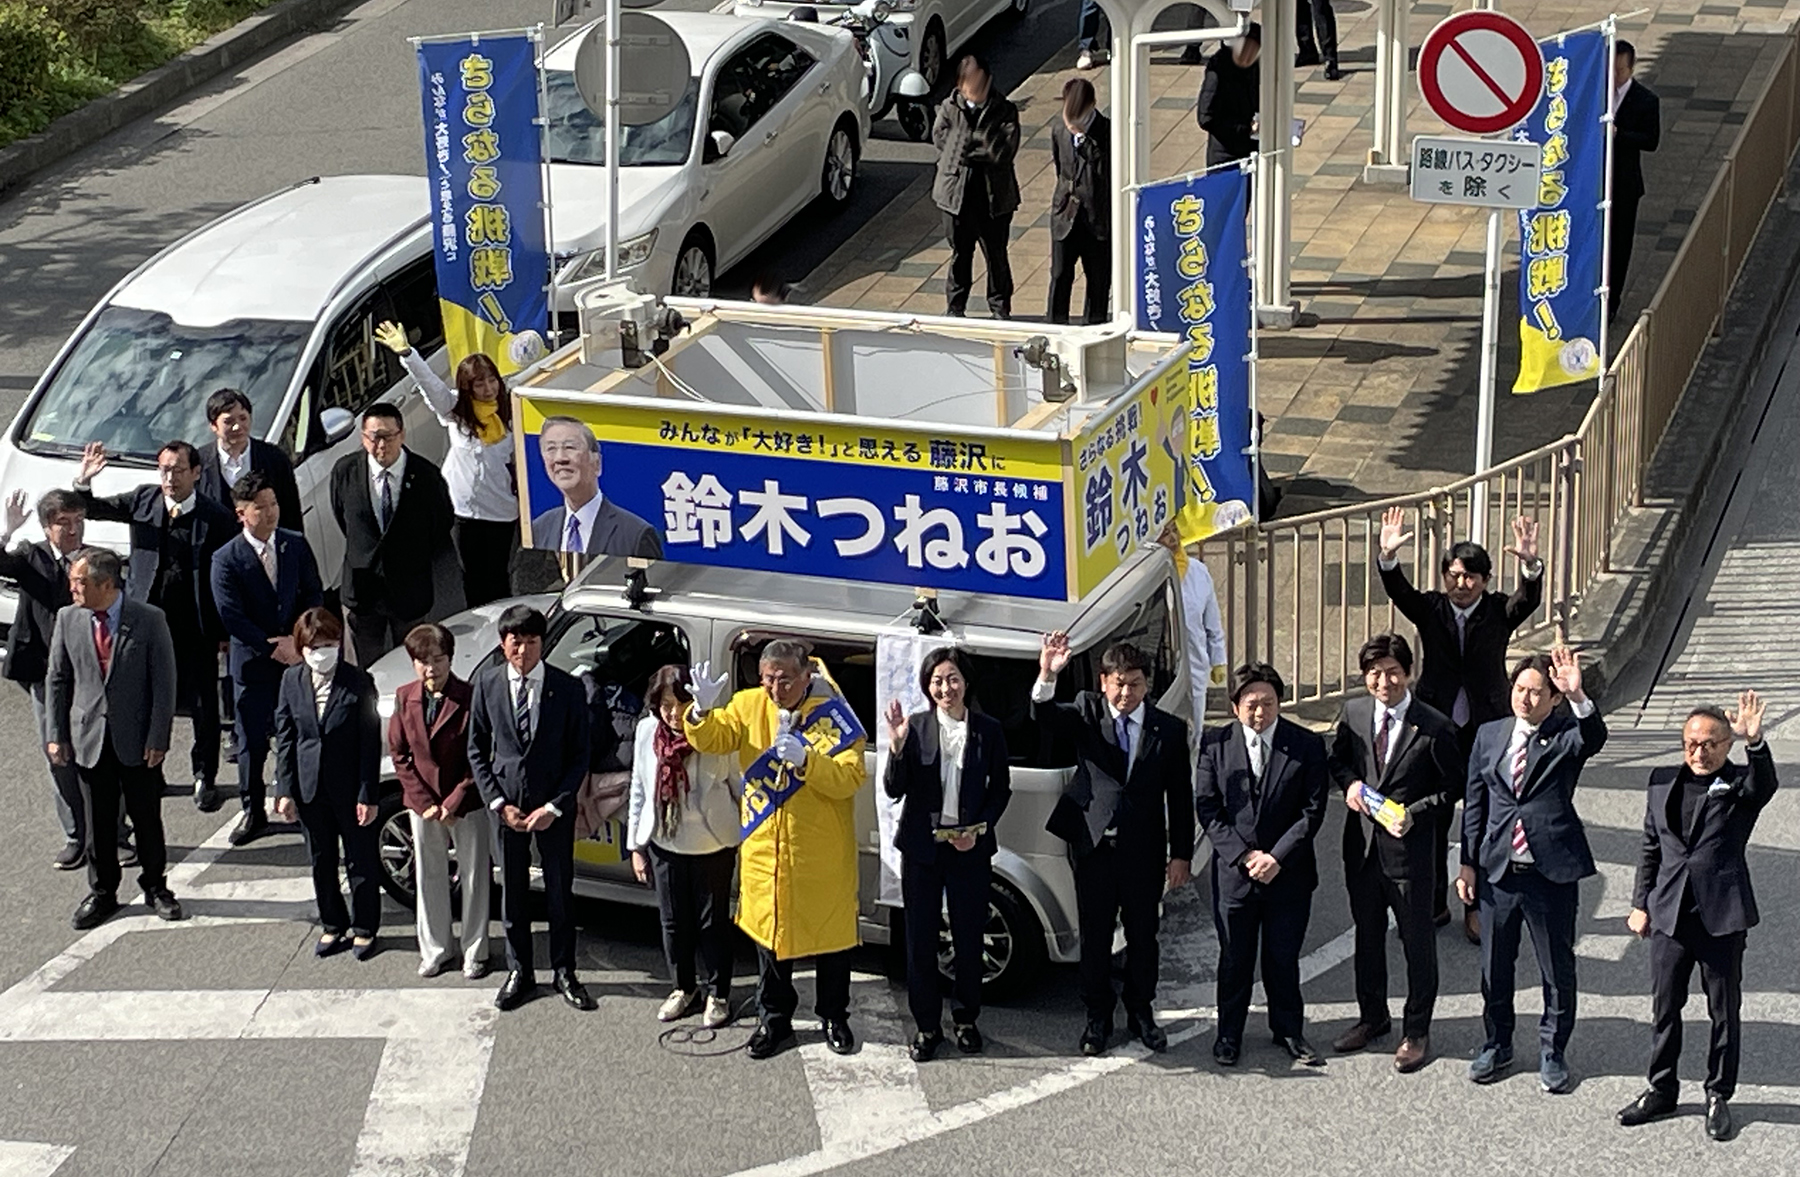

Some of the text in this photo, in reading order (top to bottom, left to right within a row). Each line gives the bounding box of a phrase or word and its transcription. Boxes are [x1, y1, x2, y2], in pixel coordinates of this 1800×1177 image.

[1419, 147, 1535, 174] 路線バス・タクシー
[658, 419, 1007, 472] みんなが「大好き！」と思える藤沢に
[933, 475, 1050, 502] 藤沢市長候補
[661, 470, 1049, 579] 鈴木つねお
